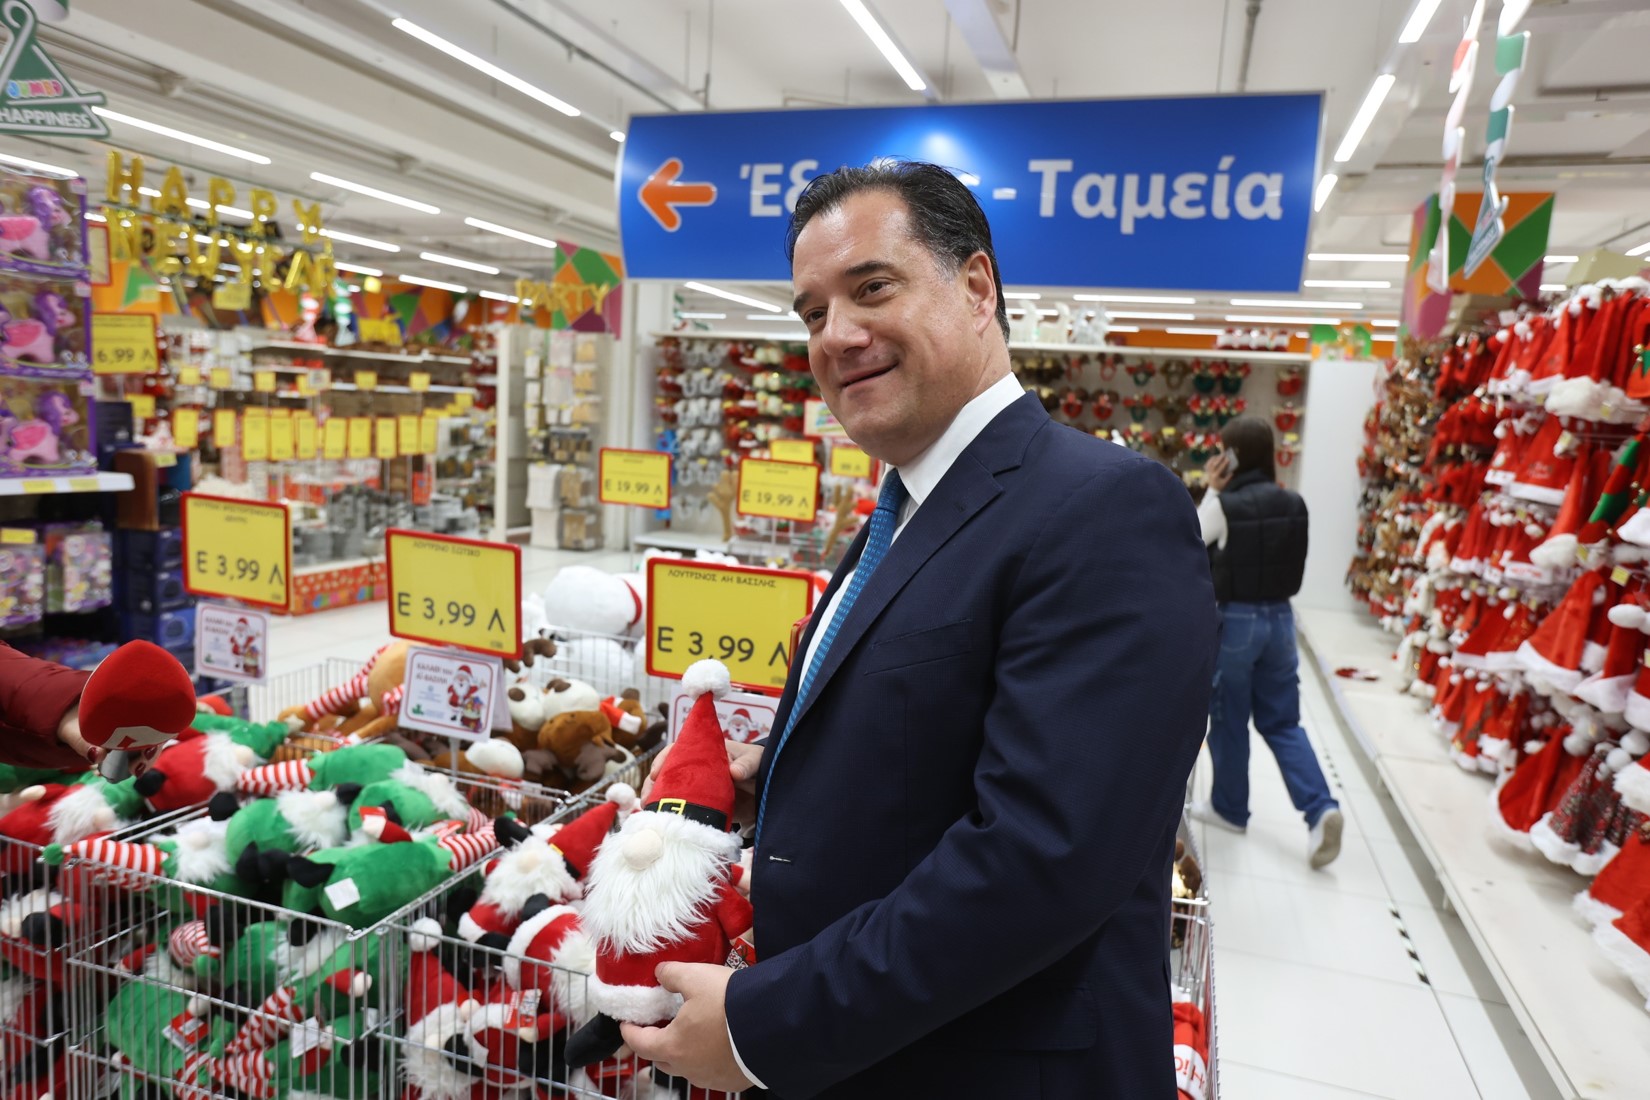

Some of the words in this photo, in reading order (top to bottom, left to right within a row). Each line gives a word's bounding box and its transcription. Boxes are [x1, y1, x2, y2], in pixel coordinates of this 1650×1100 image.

[0, 107, 92, 129] HAPPINESS
[1028, 155, 1284, 235] Ταμεία
[515, 278, 610, 315] PARTY
[217, 554, 260, 582] 3,99
[668, 569, 717, 582] ΛΟΥΤΡΙΝΟΣ
[736, 576, 777, 589] ΒΑΣΙΛΗΣ
[422, 597, 476, 627] 3,99
[688, 632, 755, 663] 3,99
